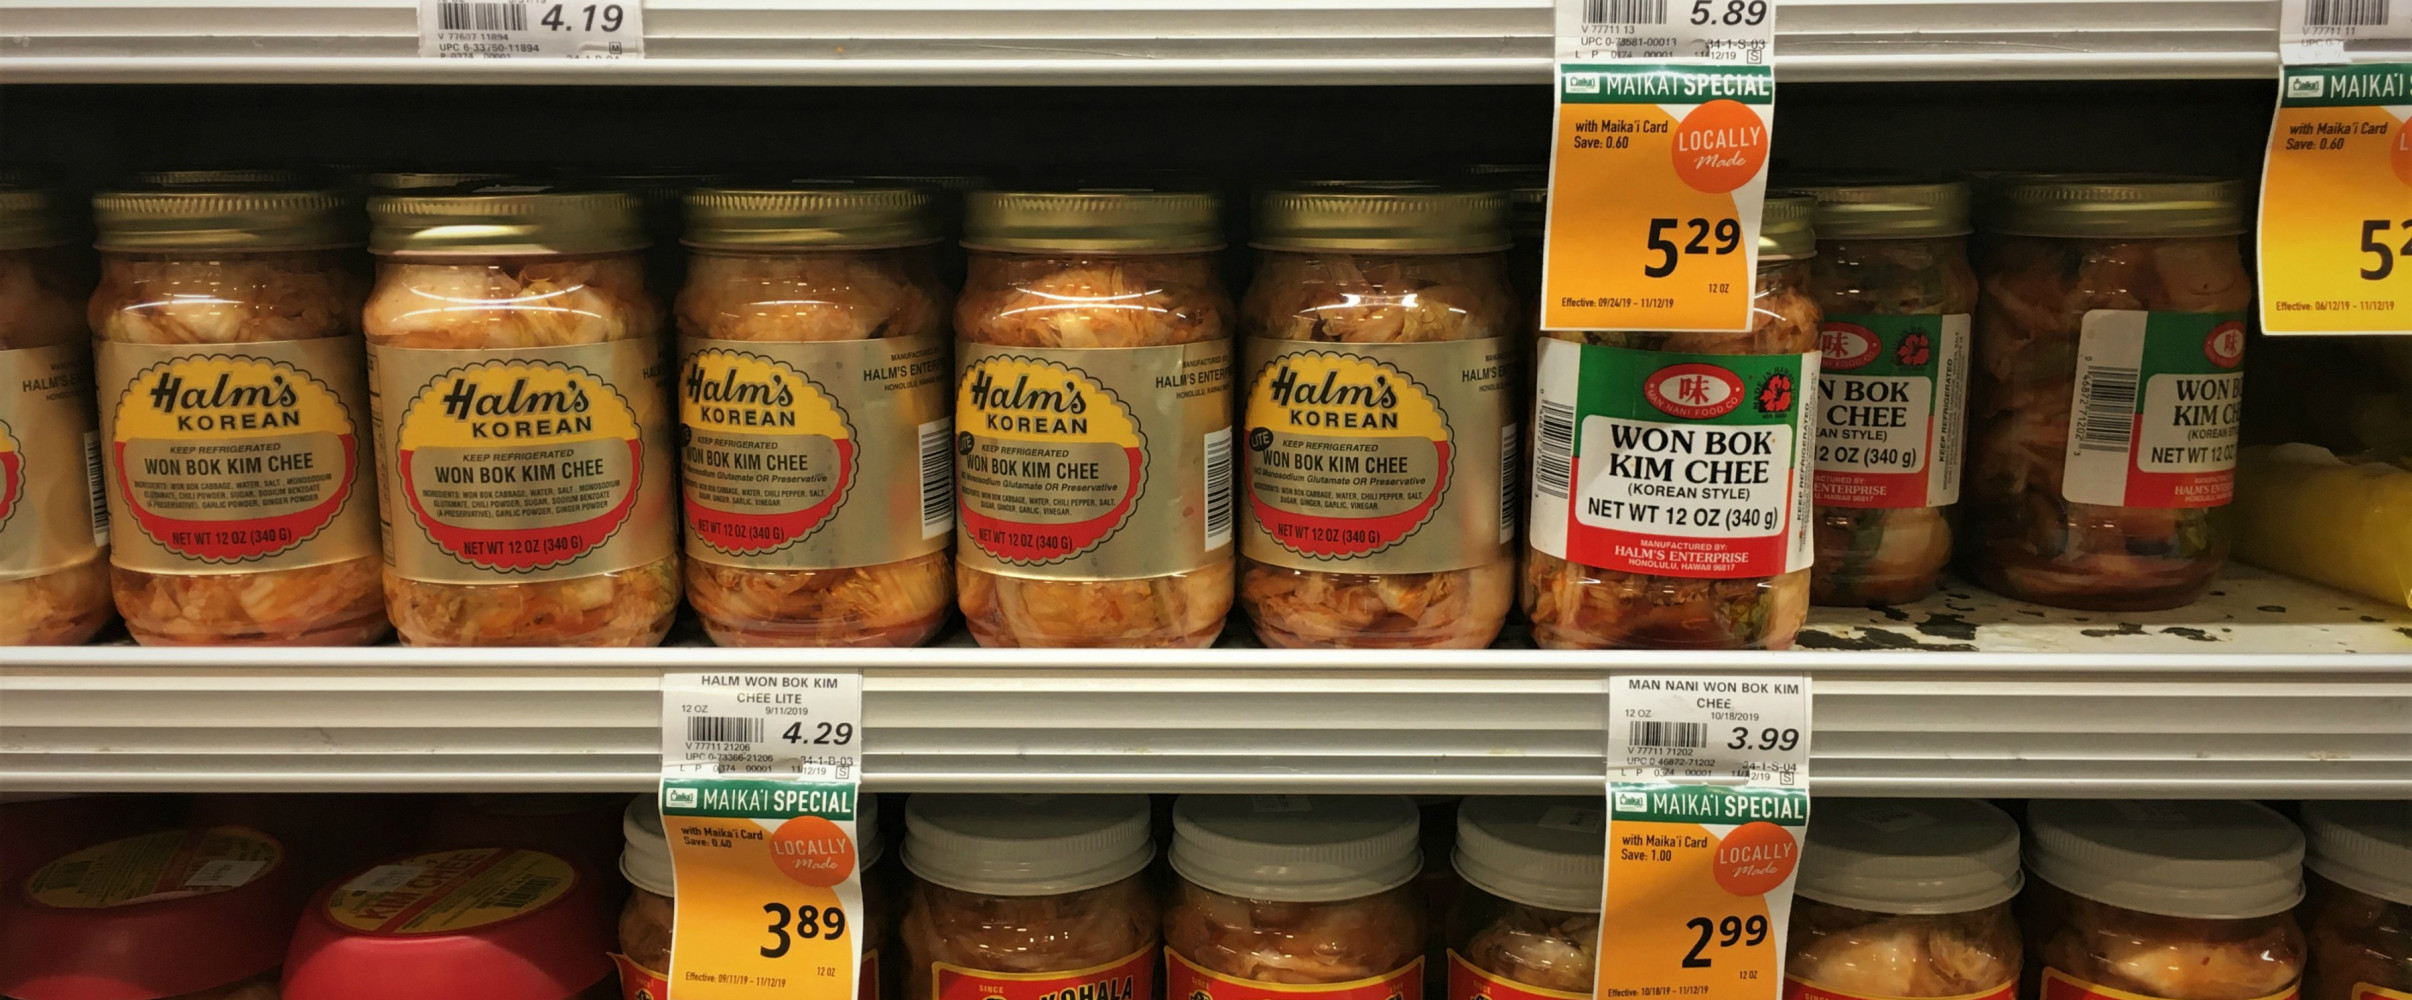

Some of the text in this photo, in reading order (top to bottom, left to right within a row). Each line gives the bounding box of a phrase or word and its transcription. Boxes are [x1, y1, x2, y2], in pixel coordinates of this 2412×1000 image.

[541, 4, 624, 32] 4.19
[1690, 0, 1767, 26] 5.89
[1581, 26, 1635, 34] V 77711 13
[1684, 74, 1770, 96] SPECIAL
[1575, 120, 1598, 133] with
[1643, 120, 1668, 133] Card
[2290, 123, 2313, 135] with
[2361, 122, 2388, 135] Card
[1574, 136, 1629, 149] Save: 0.60
[1679, 126, 1761, 151] LOCALLY
[2286, 138, 2344, 150] Save: 0.60
[1693, 151, 1747, 170] Made
[1708, 284, 1729, 293] 12 OZ
[1562, 297, 1596, 307] Effective:
[1640, 298, 1674, 308] 11/12/19
[2276, 301, 2312, 311] Effective:
[2360, 301, 2395, 311] 11/12/19
[150, 373, 297, 413] Halm's
[972, 370, 1087, 414] Halm's
[1271, 366, 1397, 409] Halm's
[1845, 381, 1909, 403] BOK
[2176, 379, 2229, 400] WON
[443, 378, 590, 420] Halm's
[178, 411, 300, 431] KOREAN
[701, 406, 796, 427] KOREAN
[987, 413, 1088, 434] KOREAN
[1290, 409, 1398, 429] KOREAN
[1827, 405, 1907, 428] CHEE
[2173, 405, 2218, 427] KIM
[472, 416, 592, 438] KOREAN
[1611, 424, 1772, 456] WON BOK
[1842, 429, 1888, 443] STYLE)
[1282, 440, 1378, 452] KEEP REFRIGERATED
[1262, 450, 1408, 474] WON BOK KIM CHEE
[2151, 447, 2207, 464] NET WT
[144, 453, 313, 476] WON BOK KIM CHEE
[435, 459, 604, 484] WON BOK KIM CHEE
[1609, 453, 1769, 484] KIM CHEE
[1628, 483, 1750, 501] (KOREAN STYLE)
[1588, 498, 1778, 531] NET WT 12 OZ (340 g)
[1640, 539, 1713, 551] MANUFACTURED
[1615, 545, 1749, 563] HALM'S ENTERPRISE
[1628, 557, 1679, 571] HONOLULU,
[701, 675, 838, 689] HALM WON BOK KIM
[1629, 679, 1799, 694] MAN NANI WON BOK KIM
[737, 693, 802, 704] CHEE LITE
[1697, 698, 1731, 709] CHEE
[682, 705, 808, 716] 12 OZ 9/11/2019
[1625, 709, 1759, 721] 12 OZ 10/18/2019
[782, 721, 853, 745] 4.29
[1728, 727, 1799, 751] 3.99
[686, 742, 750, 751] V 77711 21206
[1637, 747, 1663, 755] 77711
[1667, 748, 1693, 756] 71202
[773, 790, 851, 813] SPECIAL
[1725, 796, 1803, 819] SPECIAL
[681, 826, 702, 836] with
[741, 829, 763, 840] Card
[1622, 834, 1643, 846] with
[1684, 836, 1707, 848] Card
[683, 837, 710, 847] Save:
[774, 838, 847, 856] LOCALLY
[1621, 848, 1672, 861] Save: 1.00
[1719, 842, 1793, 864] LOCALLY
[792, 857, 838, 870] Made
[1734, 862, 1778, 878] Made
[686, 972, 786, 988] Effective: 09/11/19 11/12/19
[817, 967, 836, 977] 12 OZ
[1739, 971, 1757, 979] 12 OZ
[979, 984, 1004, 994] SINCE
[1608, 987, 1639, 997] Effective:
[1679, 986, 1708, 995] 11/12/19
